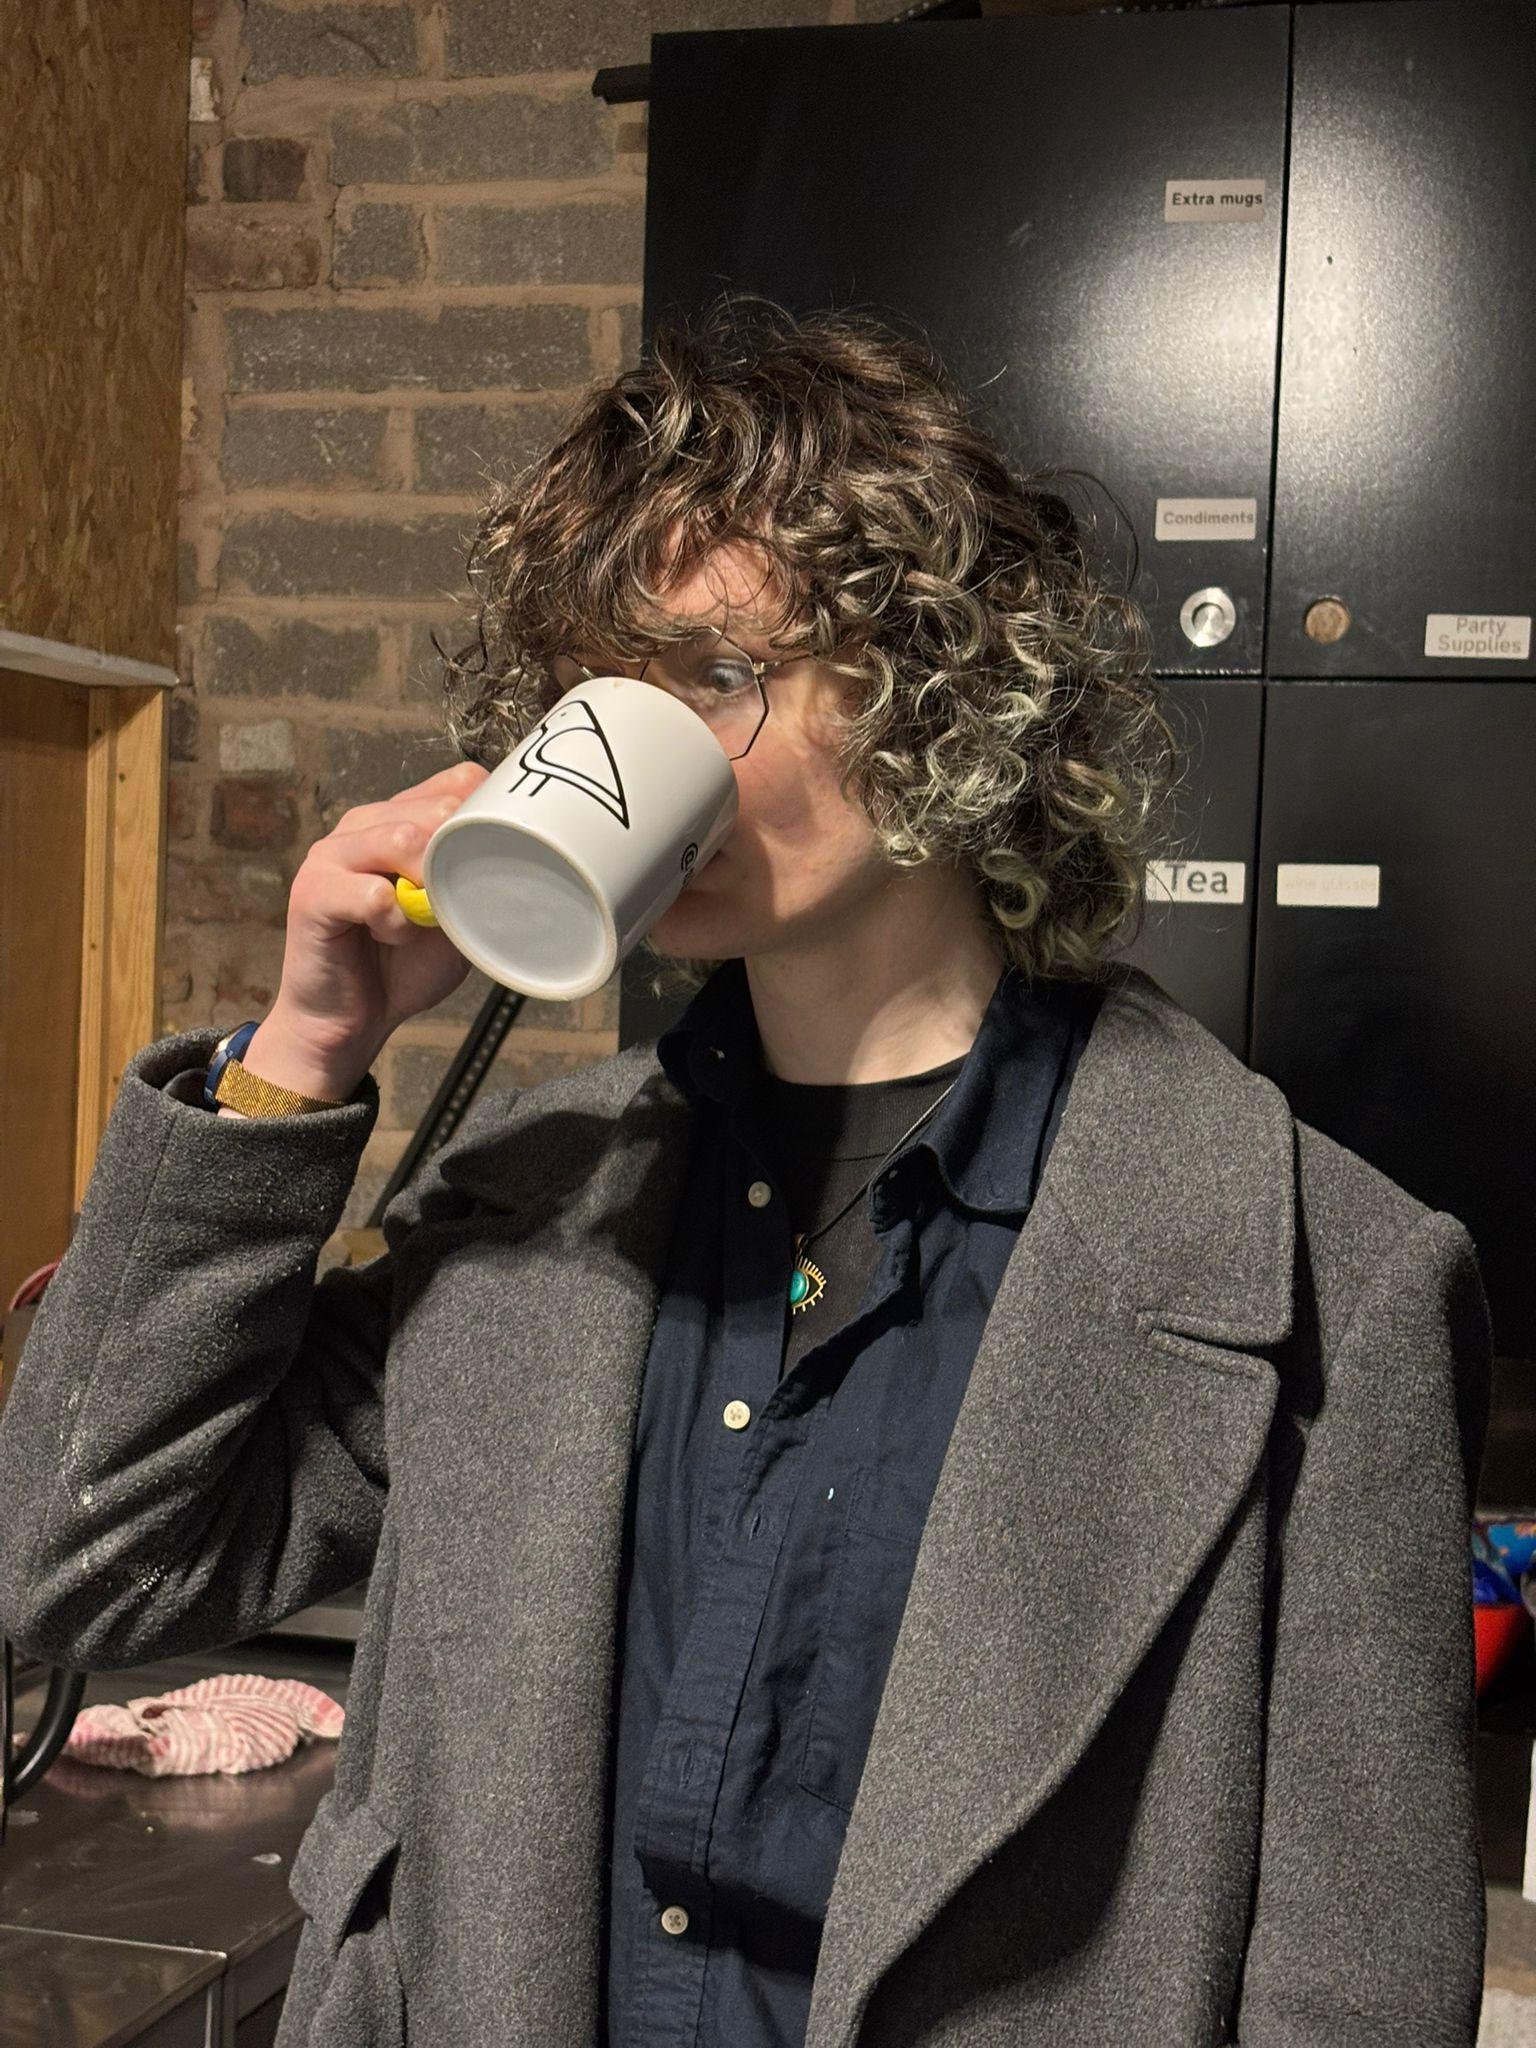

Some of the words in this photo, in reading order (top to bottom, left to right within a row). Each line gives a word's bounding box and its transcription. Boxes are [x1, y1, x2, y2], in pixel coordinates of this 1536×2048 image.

[1172, 192, 1214, 206] Extra
[1220, 193, 1263, 208] mugs
[1163, 510, 1254, 525] Condiments
[1456, 616, 1506, 637] Party
[1438, 634, 1521, 654] Supplies
[1164, 862, 1228, 894] Tea
